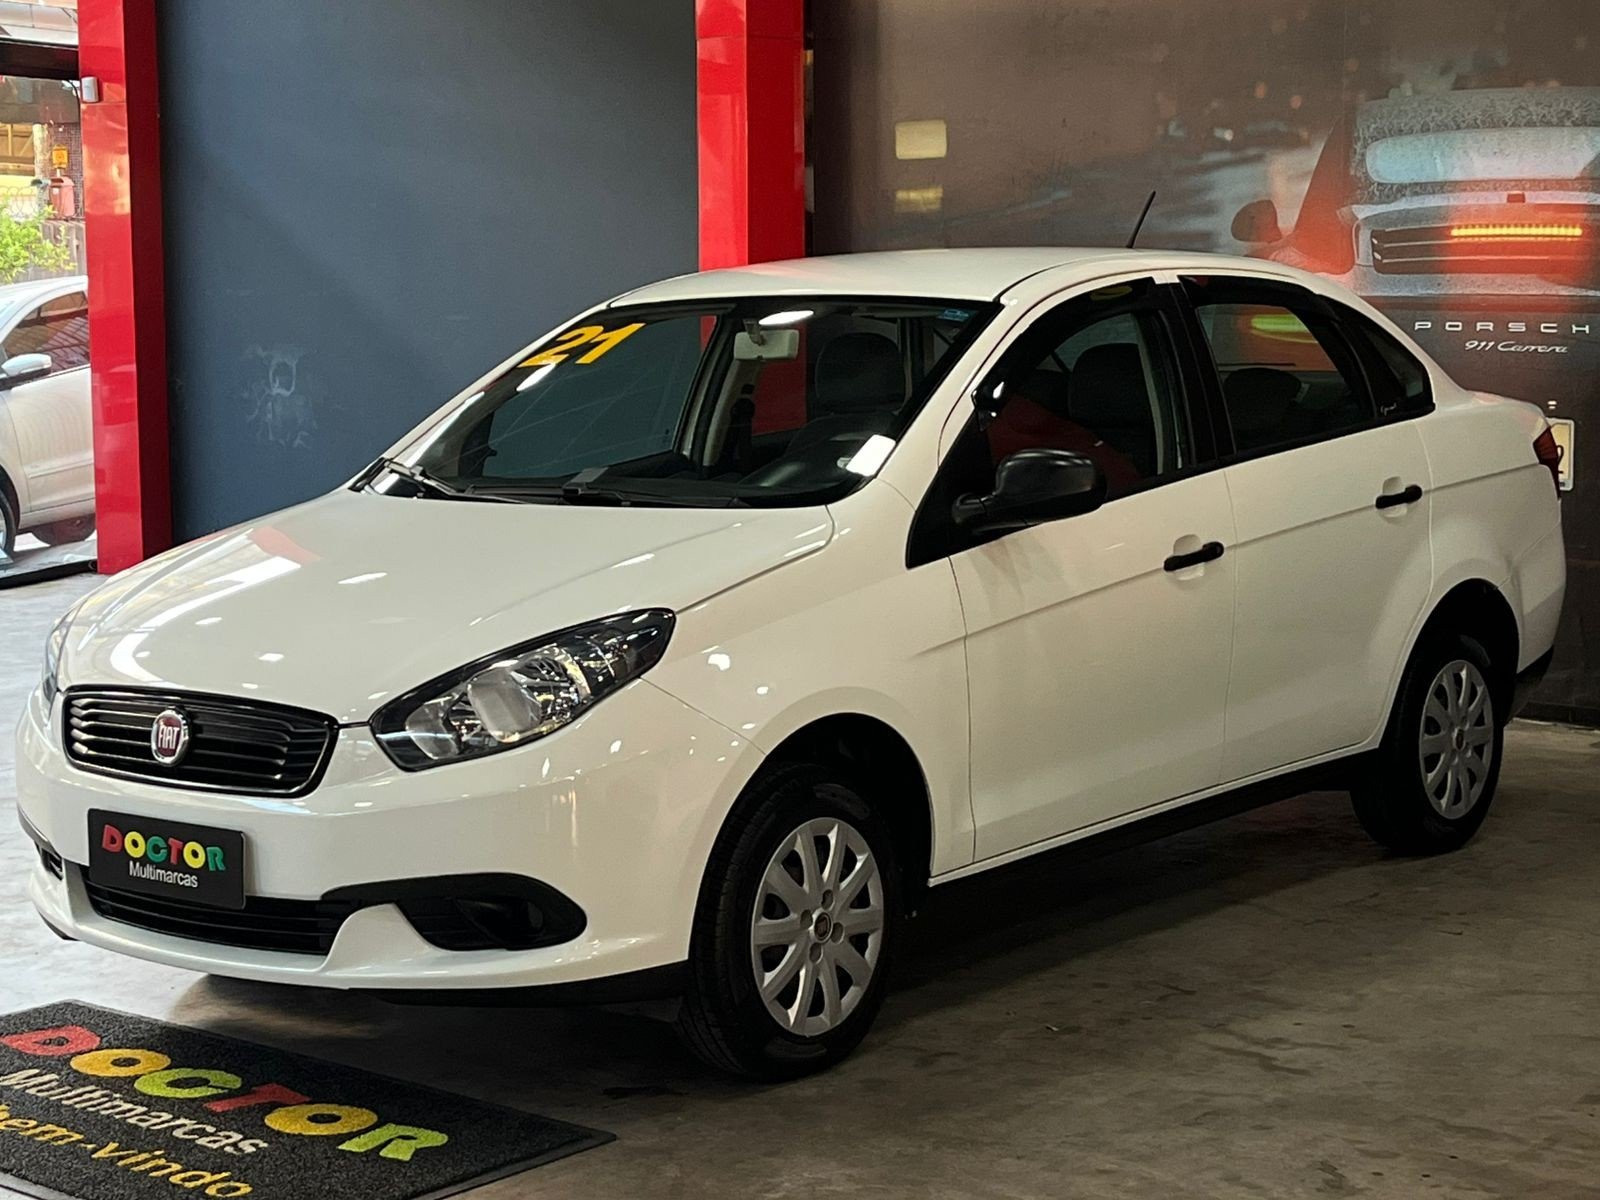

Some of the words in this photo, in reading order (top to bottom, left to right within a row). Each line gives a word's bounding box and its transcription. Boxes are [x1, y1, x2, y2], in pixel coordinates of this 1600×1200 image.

[517, 323, 646, 368] 21
[1464, 340, 1495, 351] 911
[1497, 341, 1568, 353] Carrera
[158, 725, 180, 750] FIAT
[102, 824, 226, 871] DOCTOR
[129, 860, 198, 888] Multimarcas
[0, 1025, 448, 1162] DOCTOR
[0, 1068, 269, 1156] Multimarcas
[0, 1104, 253, 1198] em-vindo
